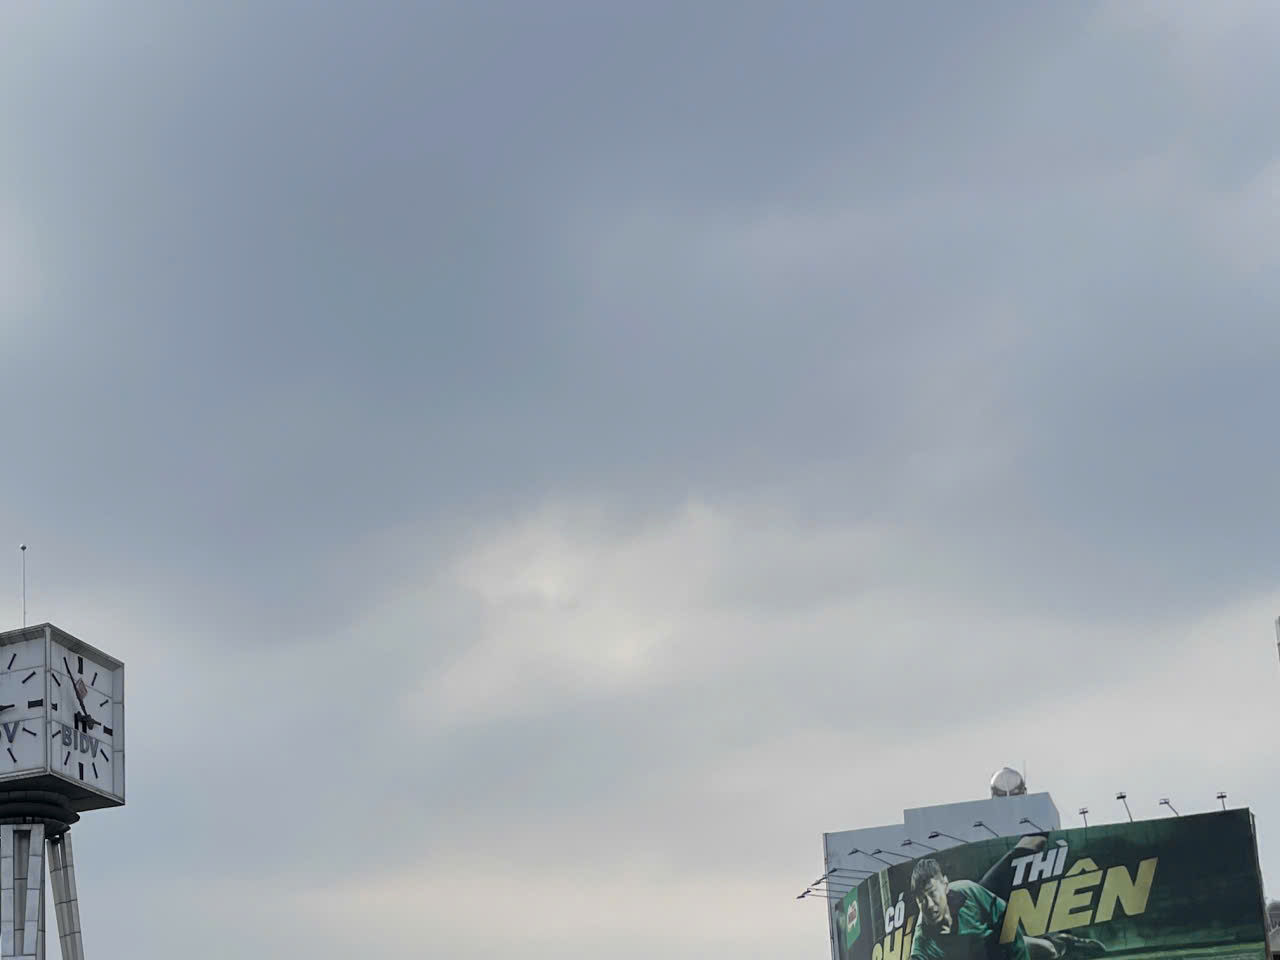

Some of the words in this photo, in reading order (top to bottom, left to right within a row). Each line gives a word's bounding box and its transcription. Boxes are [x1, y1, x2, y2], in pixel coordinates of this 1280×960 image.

[61, 724, 99, 758] BIDV
[1011, 839, 1068, 886] THÌ
[885, 892, 905, 935] CÓ
[999, 857, 1159, 944] NÊN
